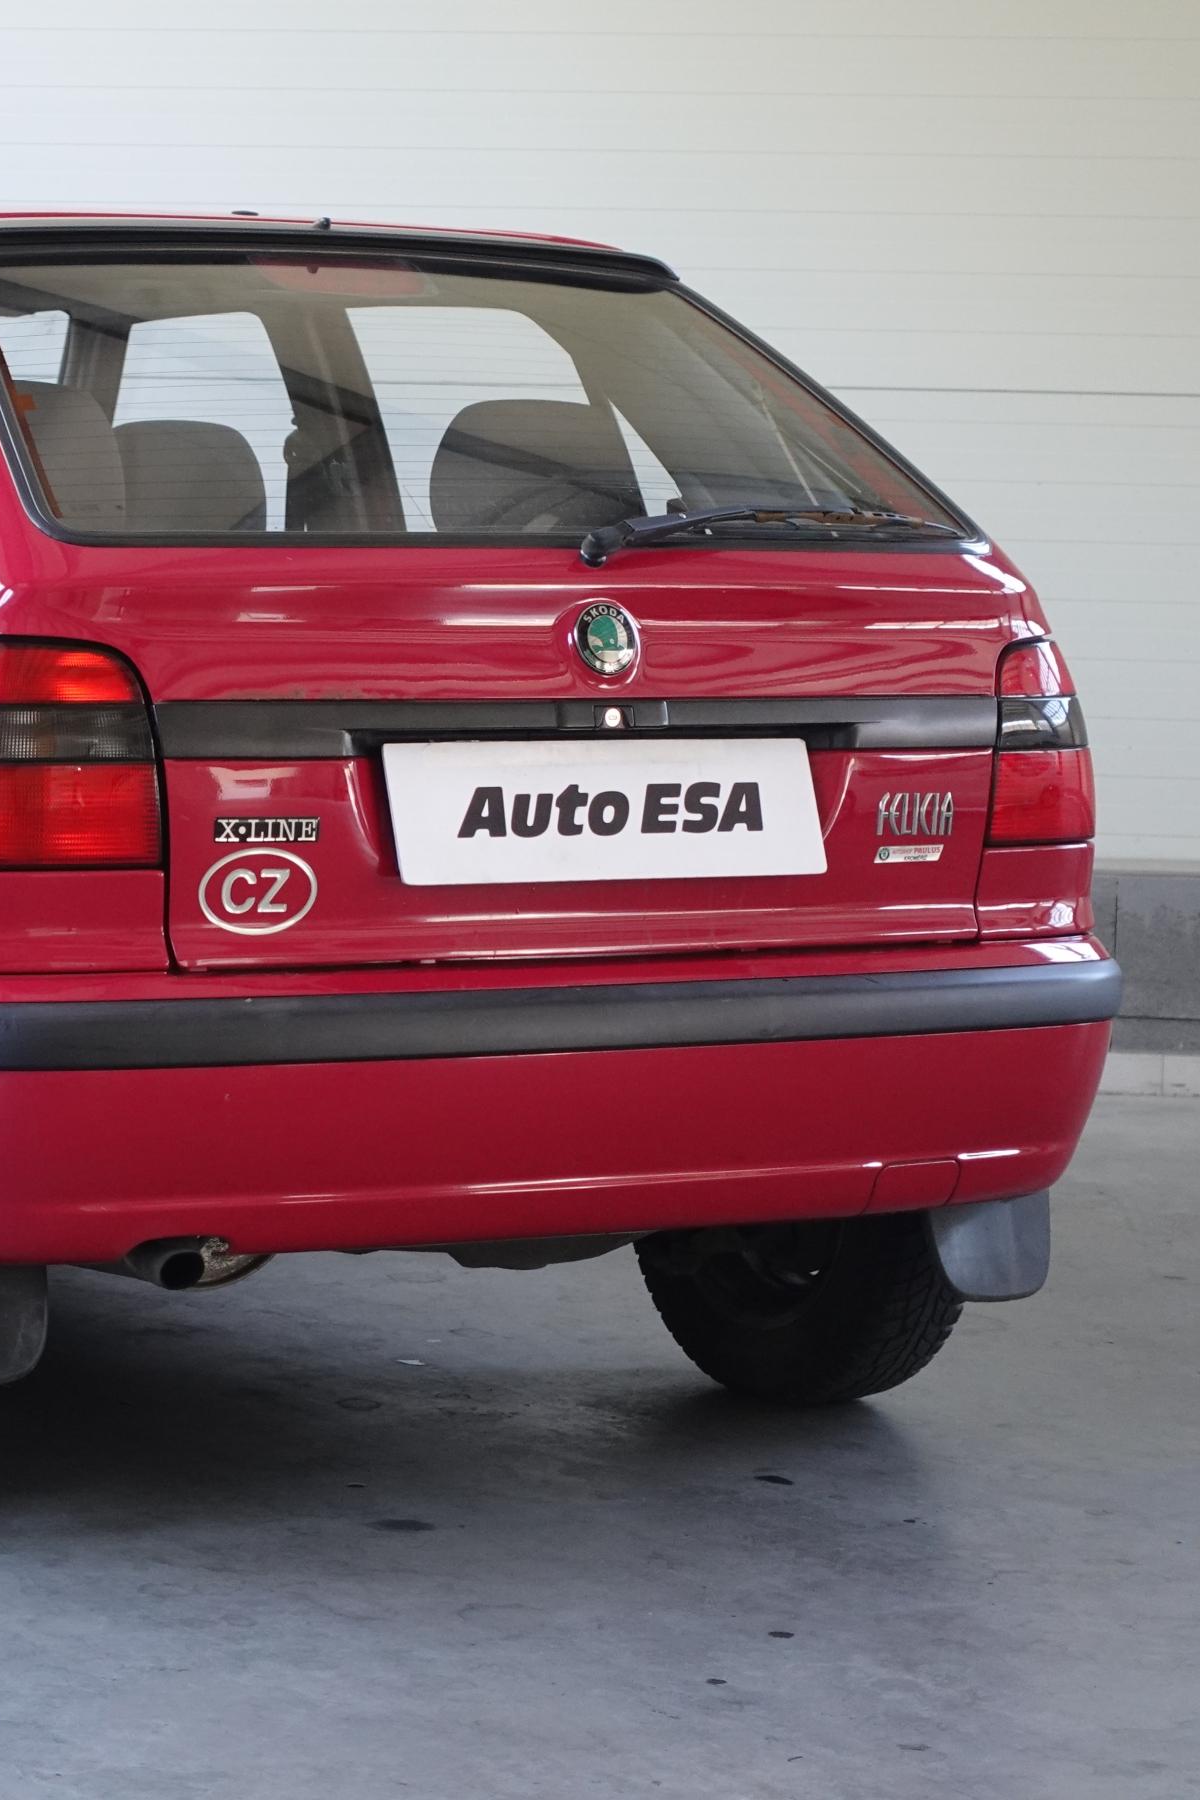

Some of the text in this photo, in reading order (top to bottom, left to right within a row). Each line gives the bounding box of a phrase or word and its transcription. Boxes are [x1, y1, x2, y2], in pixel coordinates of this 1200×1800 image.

[458, 782, 764, 838] Auto ESA
[877, 792, 953, 835] FELICIA
[221, 868, 290, 914] CZ
